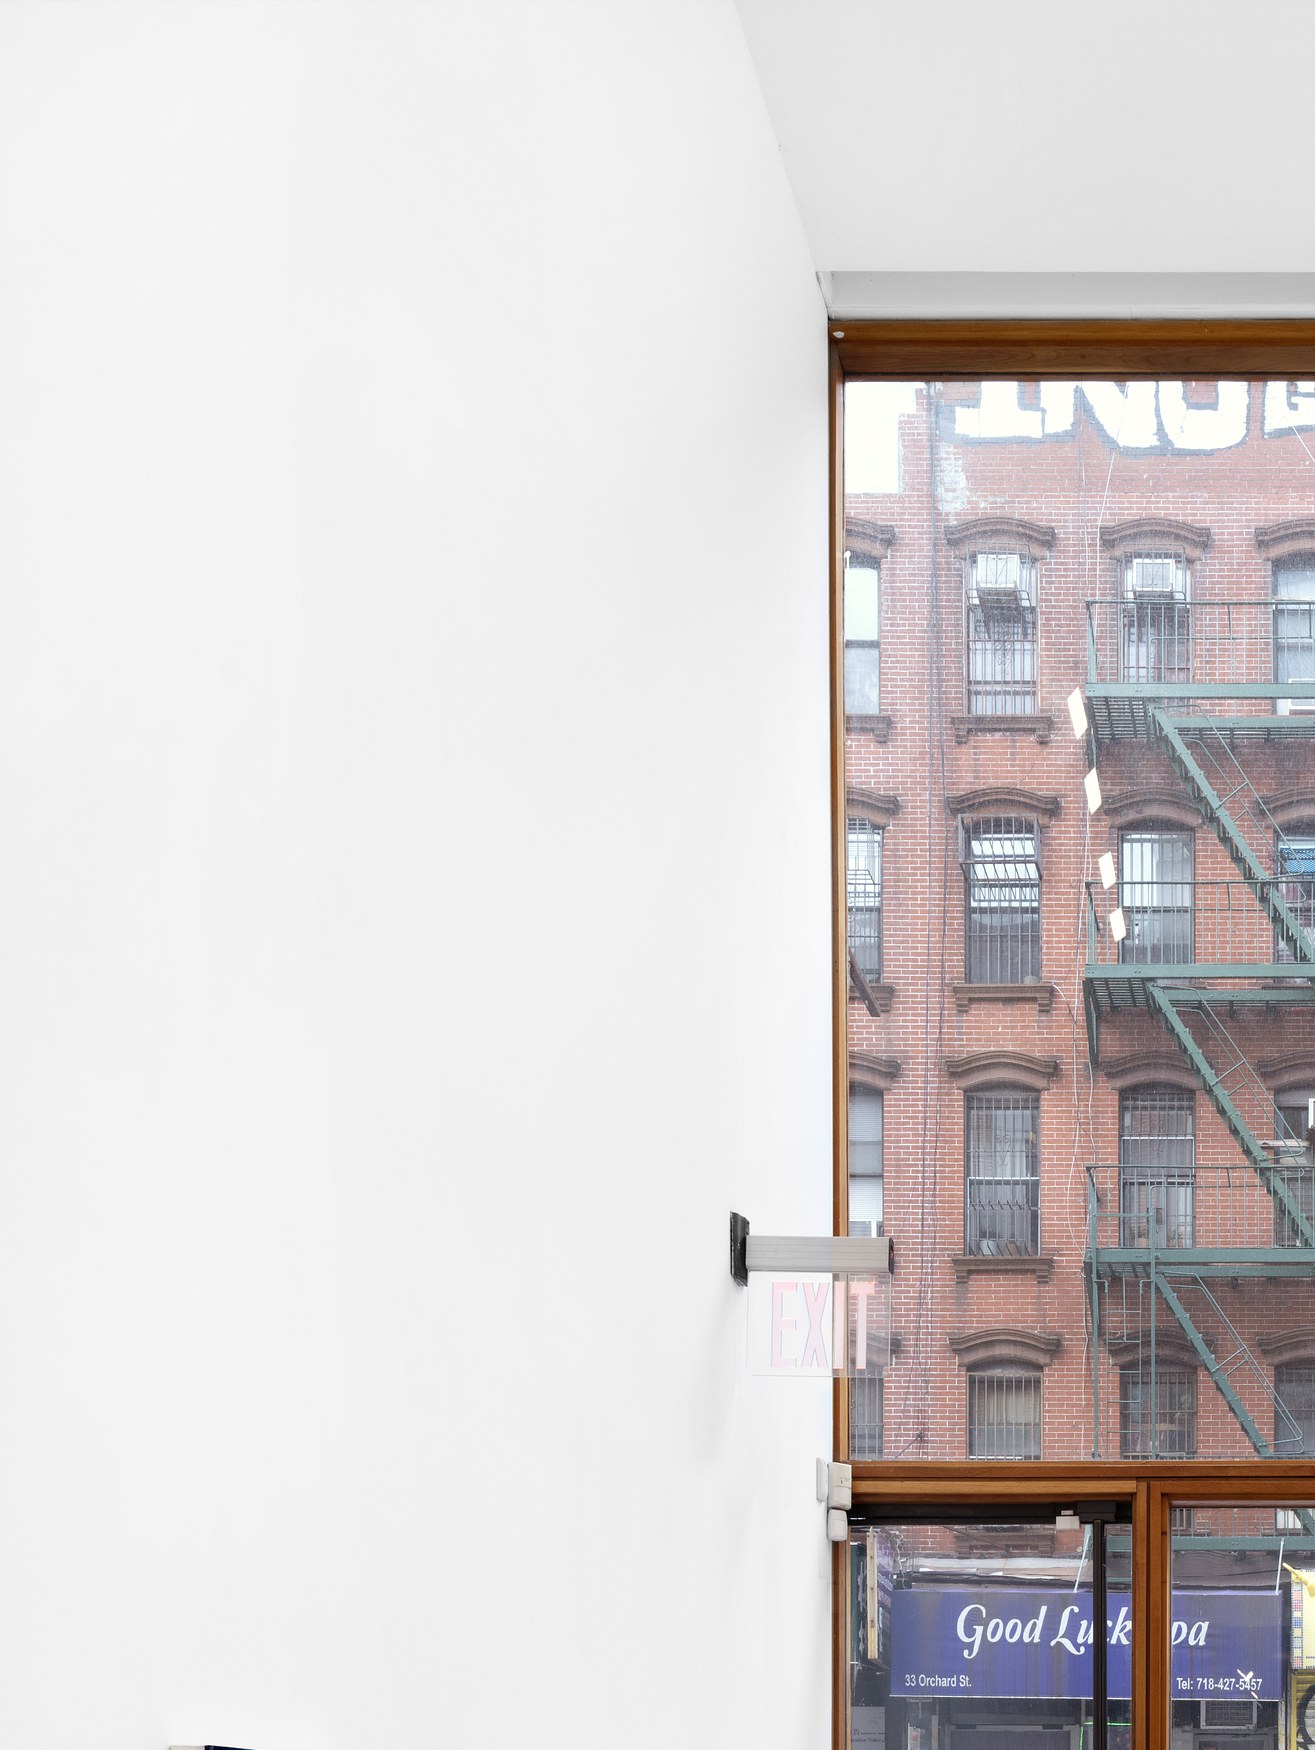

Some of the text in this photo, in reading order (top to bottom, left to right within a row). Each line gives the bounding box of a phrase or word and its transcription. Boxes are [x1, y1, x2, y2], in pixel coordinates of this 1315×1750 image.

[771, 1281, 875, 1370] EXIT
[956, 1604, 1048, 1659] Good
[1171, 1620, 1210, 1646] pa
[904, 1674, 972, 1687] 33 Orchard St.
[1176, 1677, 1263, 1691] Tel: 718-427-5457
